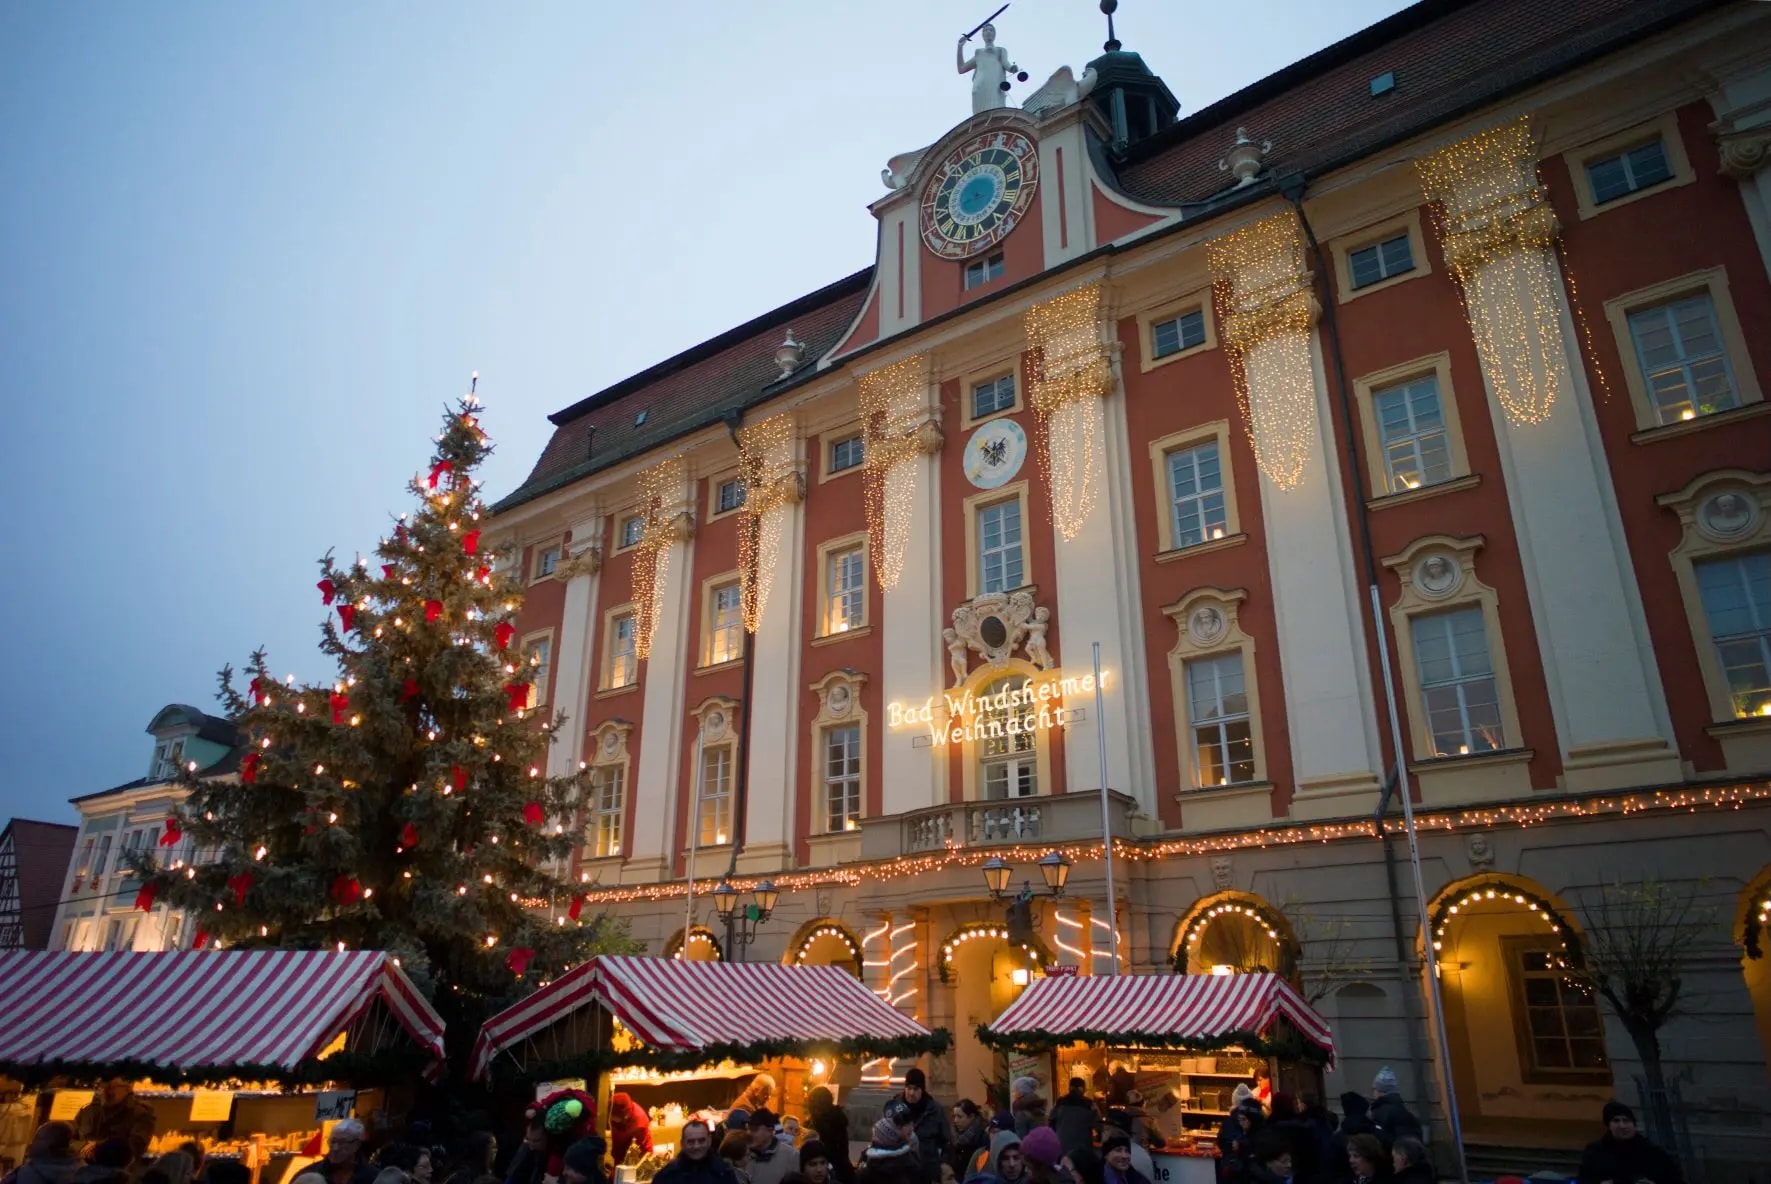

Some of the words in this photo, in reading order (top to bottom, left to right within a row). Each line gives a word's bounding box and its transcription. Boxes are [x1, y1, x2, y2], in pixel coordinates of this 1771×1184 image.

[887, 696, 933, 728] Bad
[943, 669, 1112, 718] Windsheimer
[929, 704, 1067, 748] Weihnacht
